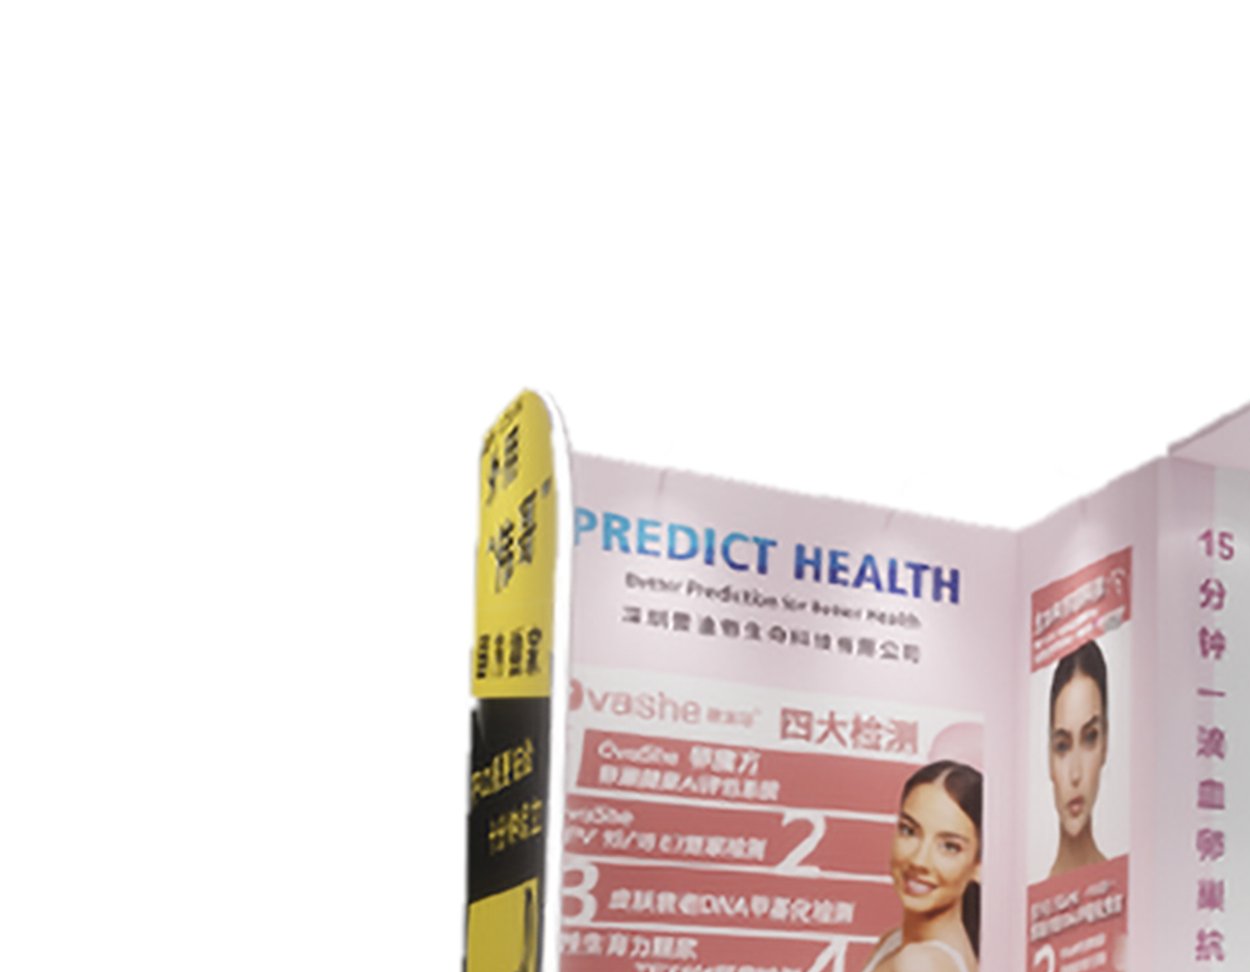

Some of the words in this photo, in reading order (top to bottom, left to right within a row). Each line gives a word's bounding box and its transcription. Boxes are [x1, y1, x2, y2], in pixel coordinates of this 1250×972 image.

[573, 506, 778, 576] PREDICT
[793, 543, 962, 605] HEALTH
[780, 707, 919, 754] 四大检测
[780, 809, 828, 878] 2
